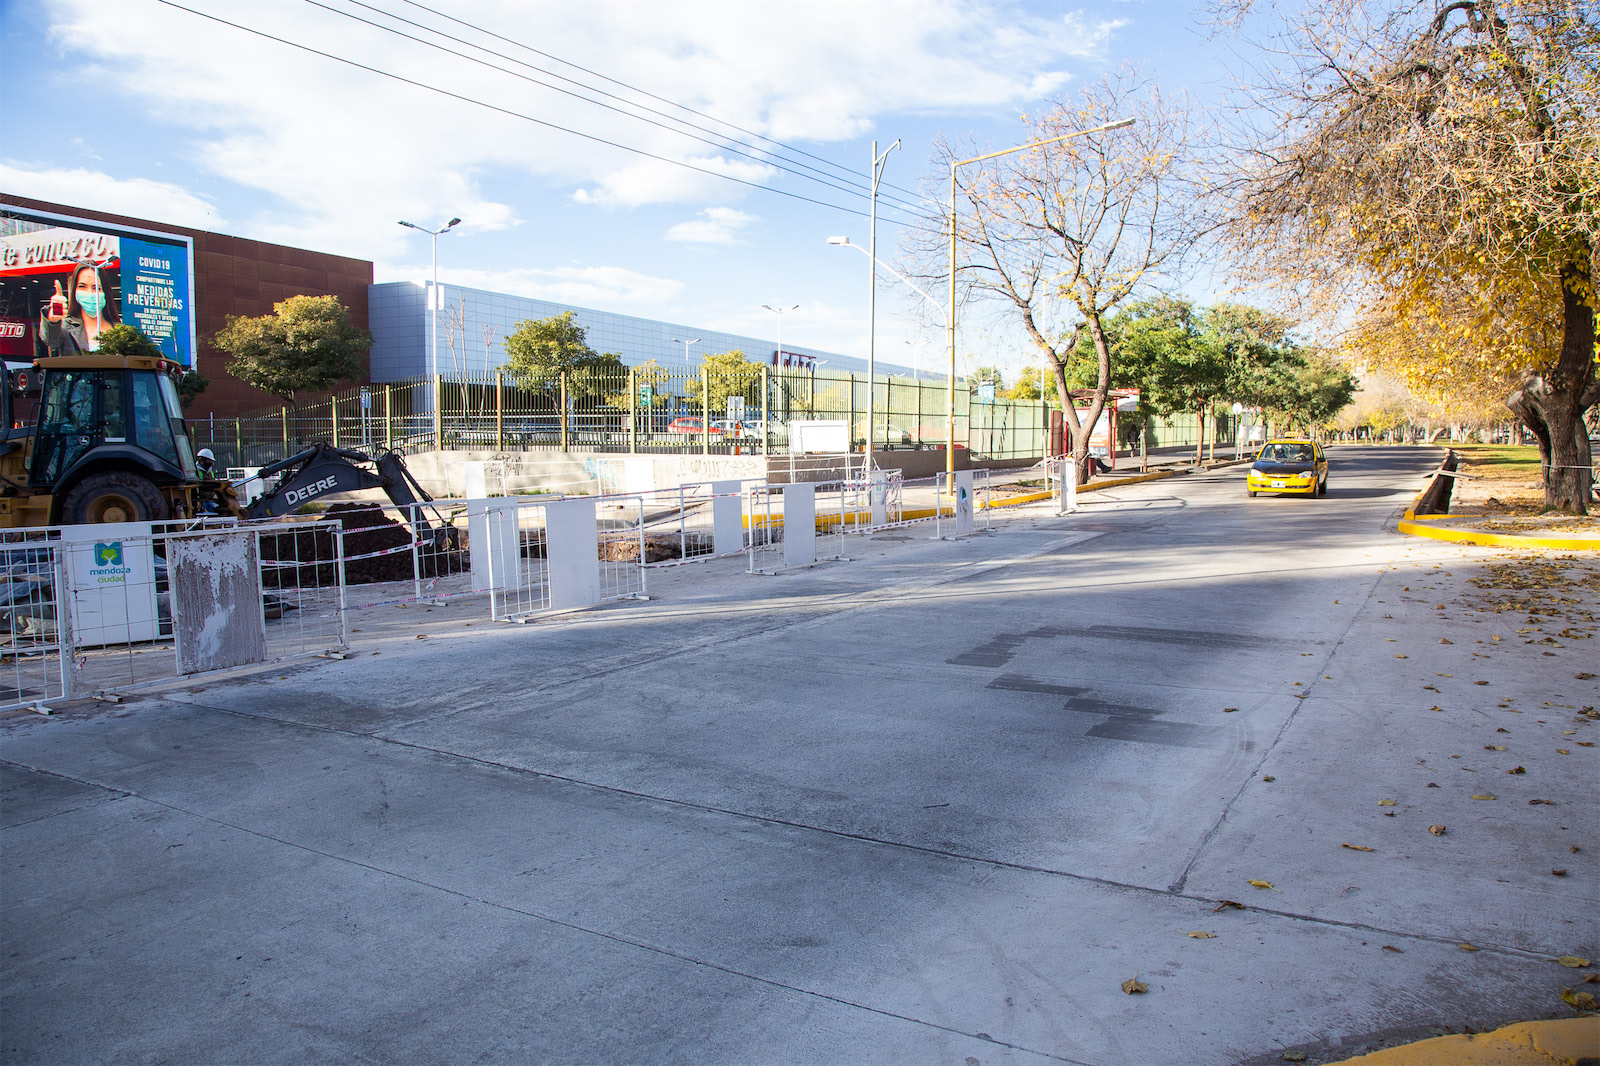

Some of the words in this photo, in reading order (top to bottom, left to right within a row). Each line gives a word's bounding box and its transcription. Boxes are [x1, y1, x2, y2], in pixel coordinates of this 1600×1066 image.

[137, 284, 174, 298] MEDIDAS
[128, 293, 183, 310] PREVENTIVAS
[284, 475, 338, 506] DEERE
[89, 567, 131, 576] mendoza
[97, 575, 126, 584] ciudad
